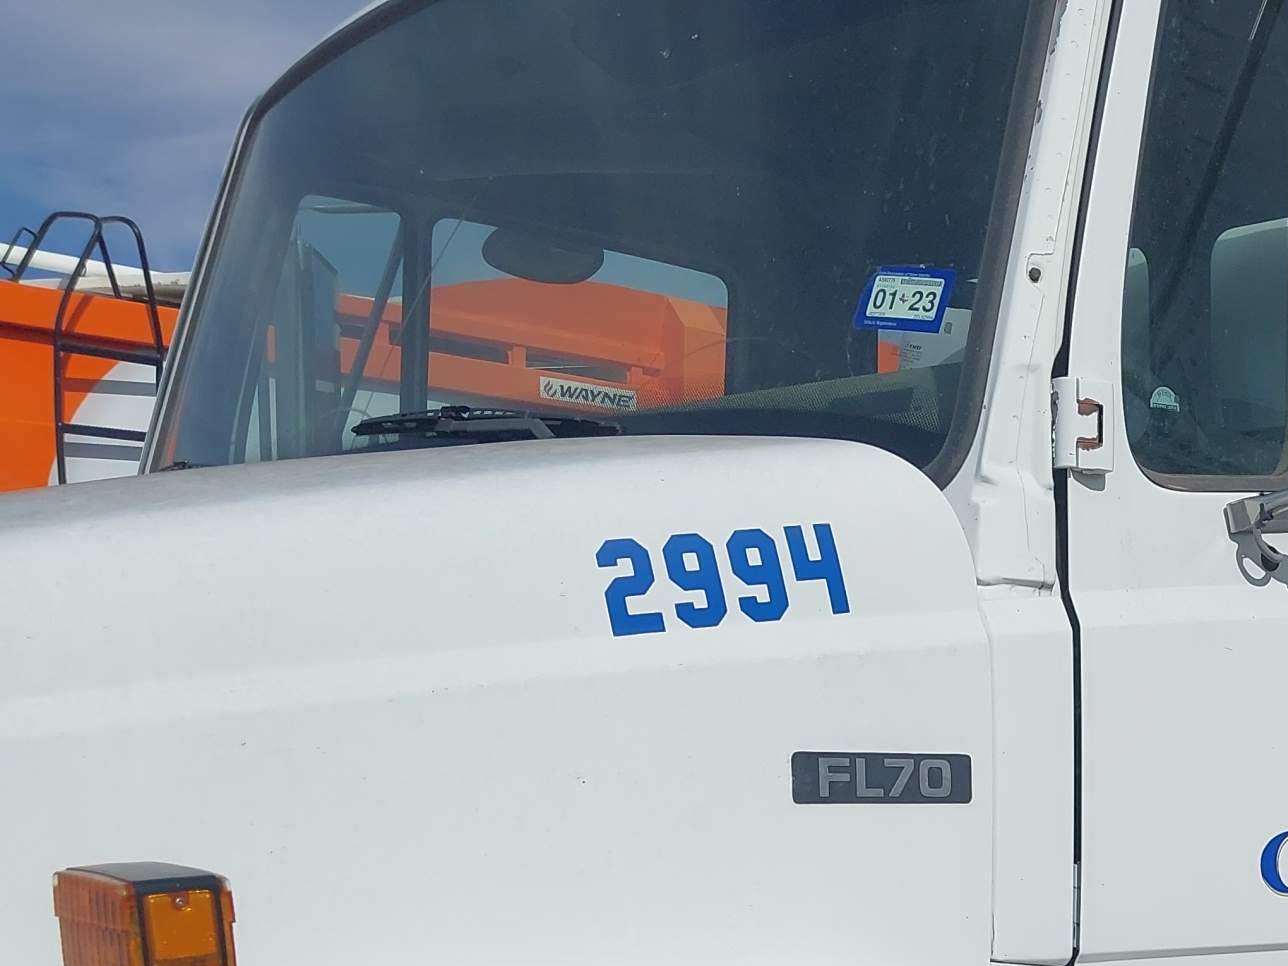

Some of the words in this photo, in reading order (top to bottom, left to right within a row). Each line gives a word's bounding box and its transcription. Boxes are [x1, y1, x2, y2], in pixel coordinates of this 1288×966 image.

[872, 288, 898, 310] 01
[907, 290, 937, 313] 23
[560, 384, 634, 409] WAYNE
[595, 522, 851, 637] 2994
[817, 756, 952, 799] FL70
